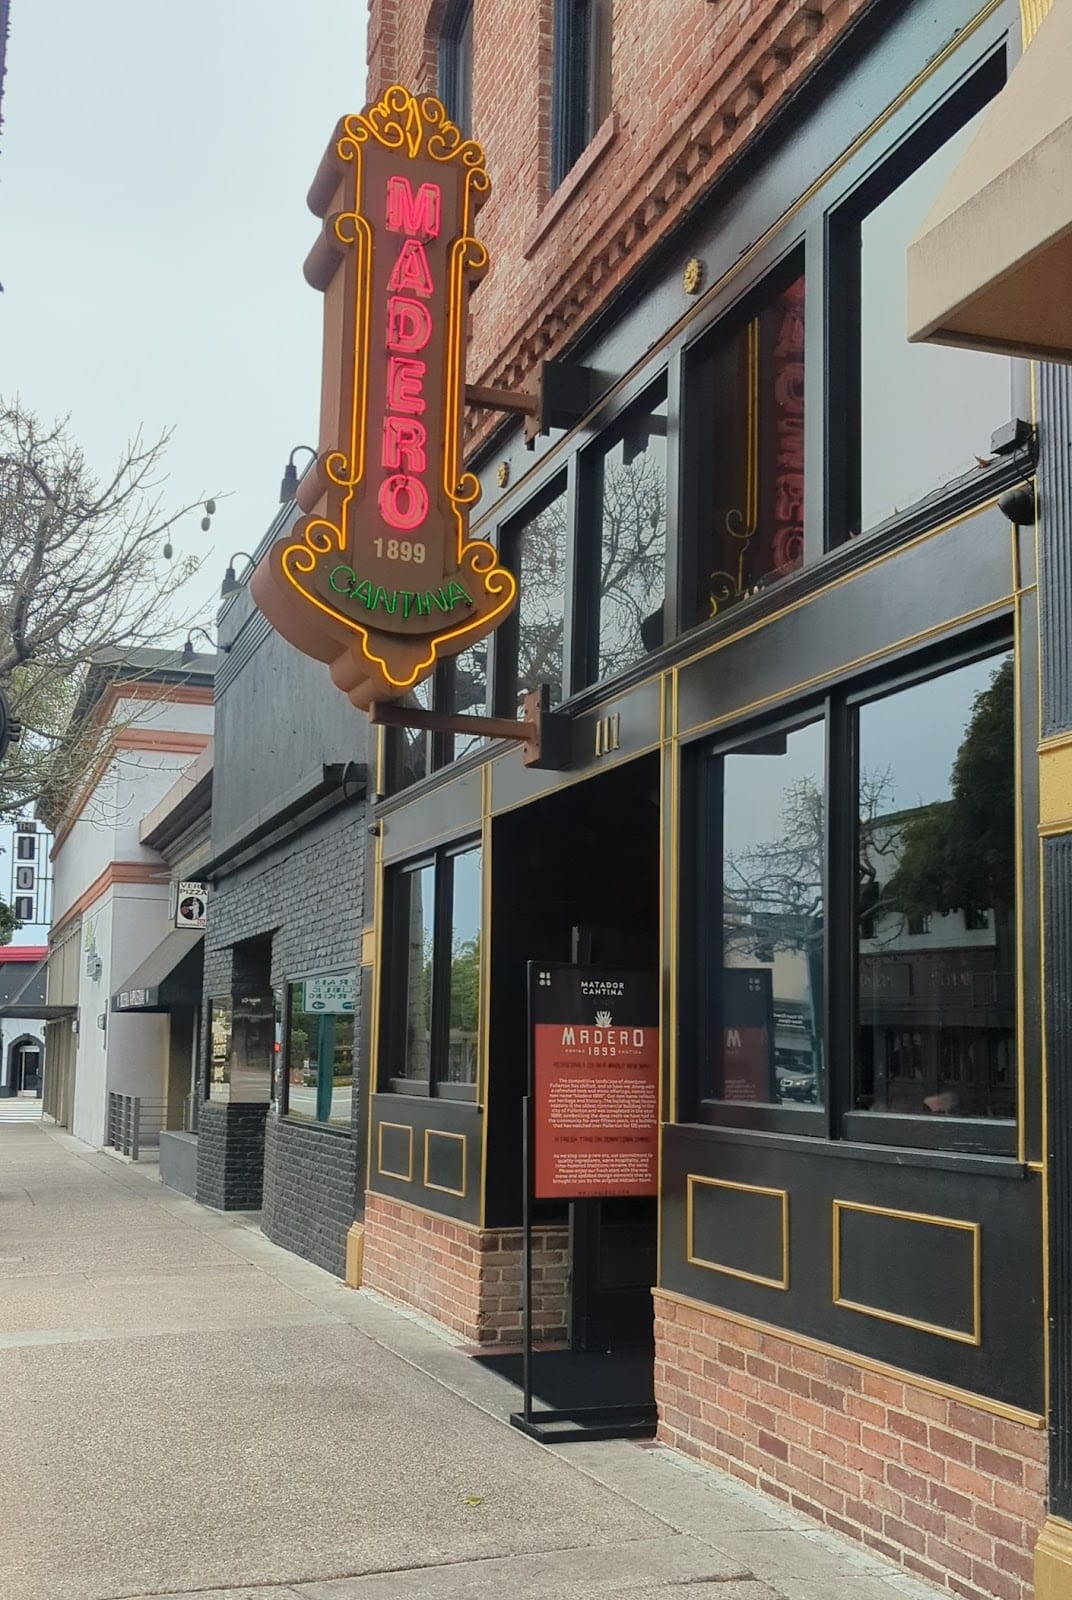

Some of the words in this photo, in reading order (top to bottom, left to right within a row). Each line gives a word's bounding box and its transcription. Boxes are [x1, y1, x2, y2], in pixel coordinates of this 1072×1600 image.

[378, 176, 441, 531] MADERO
[373, 537, 426, 563] 1899
[329, 565, 473, 618] CANTINA
[581, 981, 625, 989] MATADOR
[582, 988, 623, 996] CANTINA
[561, 1027, 644, 1047] MADERO
[588, 1047, 616, 1056] 1899
